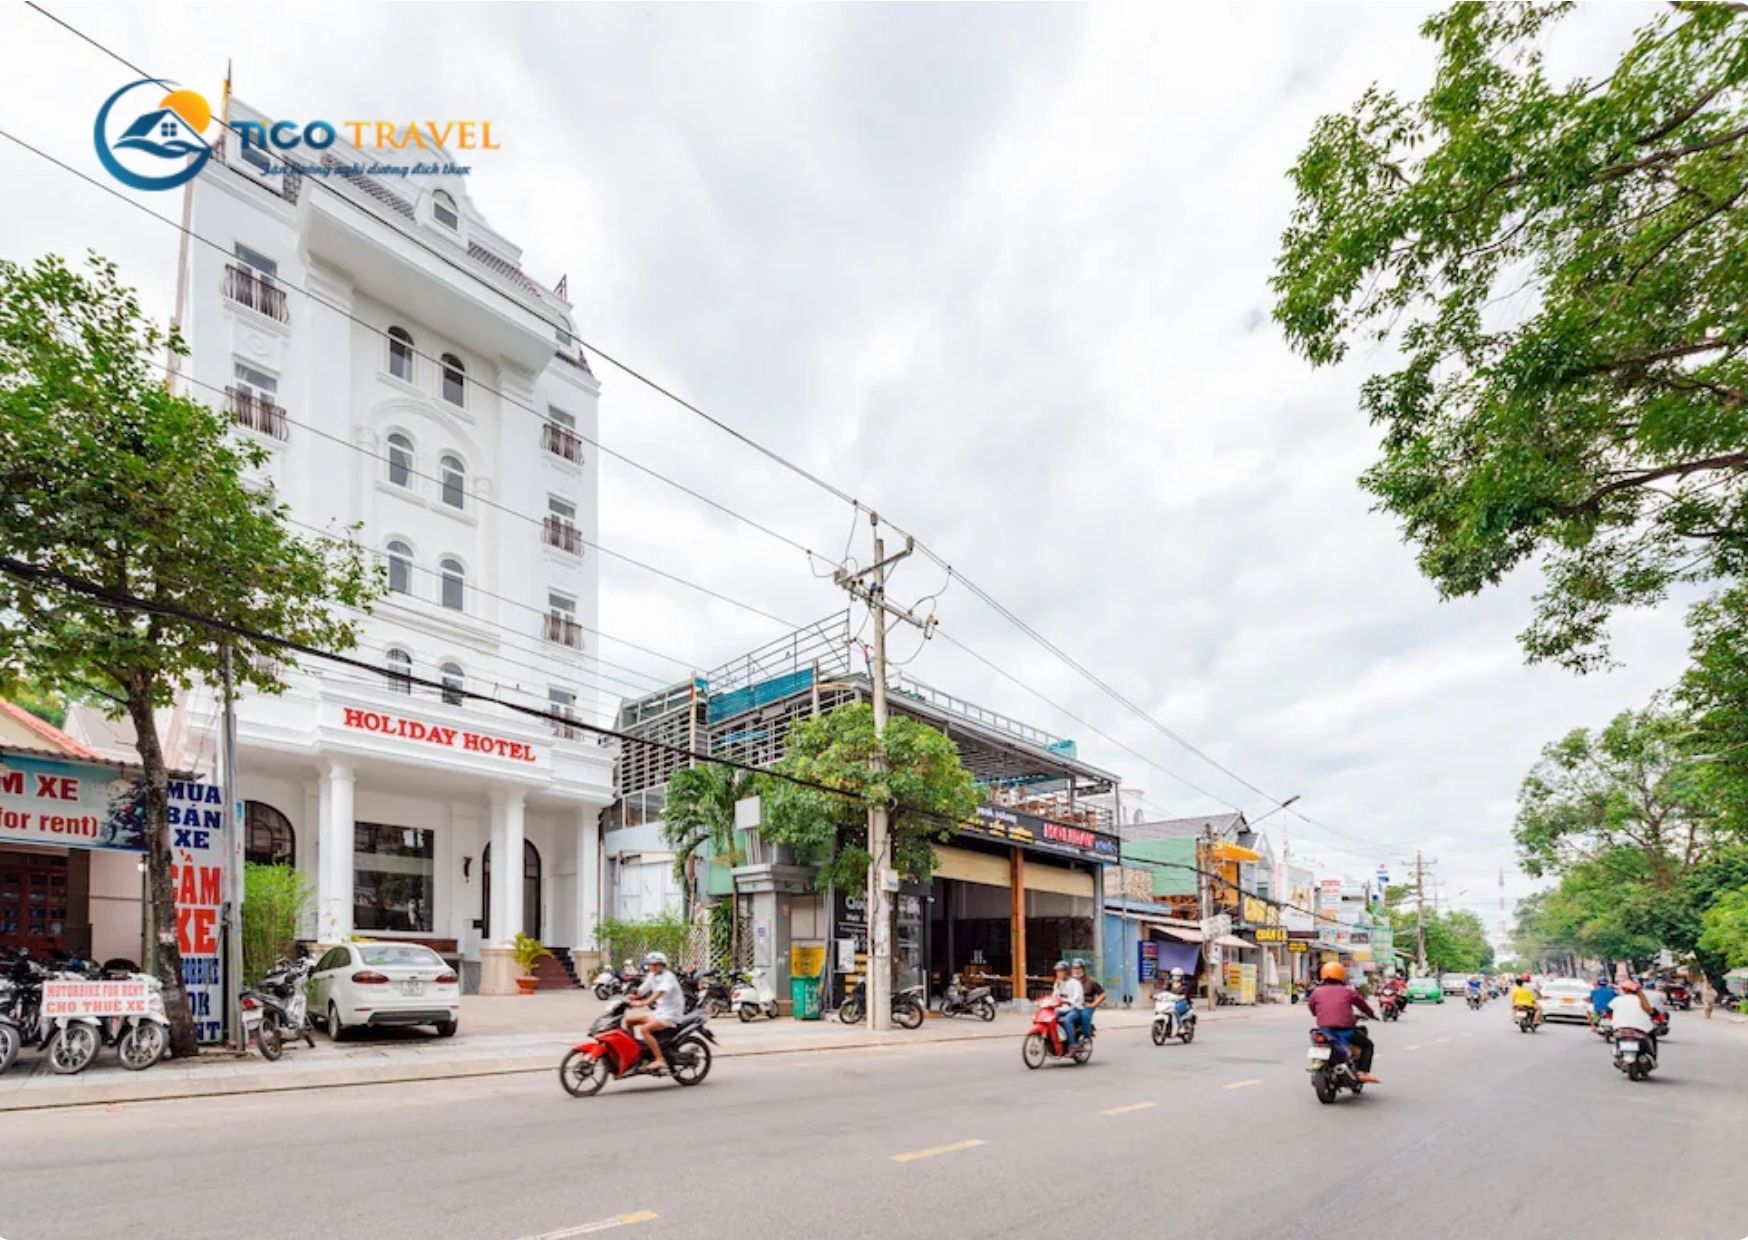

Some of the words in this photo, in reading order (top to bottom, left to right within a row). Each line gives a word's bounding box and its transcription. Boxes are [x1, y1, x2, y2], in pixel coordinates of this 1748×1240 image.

[343, 707, 458, 746] HOLIDAY
[463, 732, 536, 762] HOTEL
[36, 774, 79, 801] XE
[40, 814, 98, 838] rent)
[174, 829, 210, 849] XE
[47, 984, 100, 997] MOTORBIKE
[103, 984, 119, 997] FOR
[122, 984, 145, 997] RENT
[47, 1001, 77, 1013] CHO
[127, 1000, 145, 1012] XE
